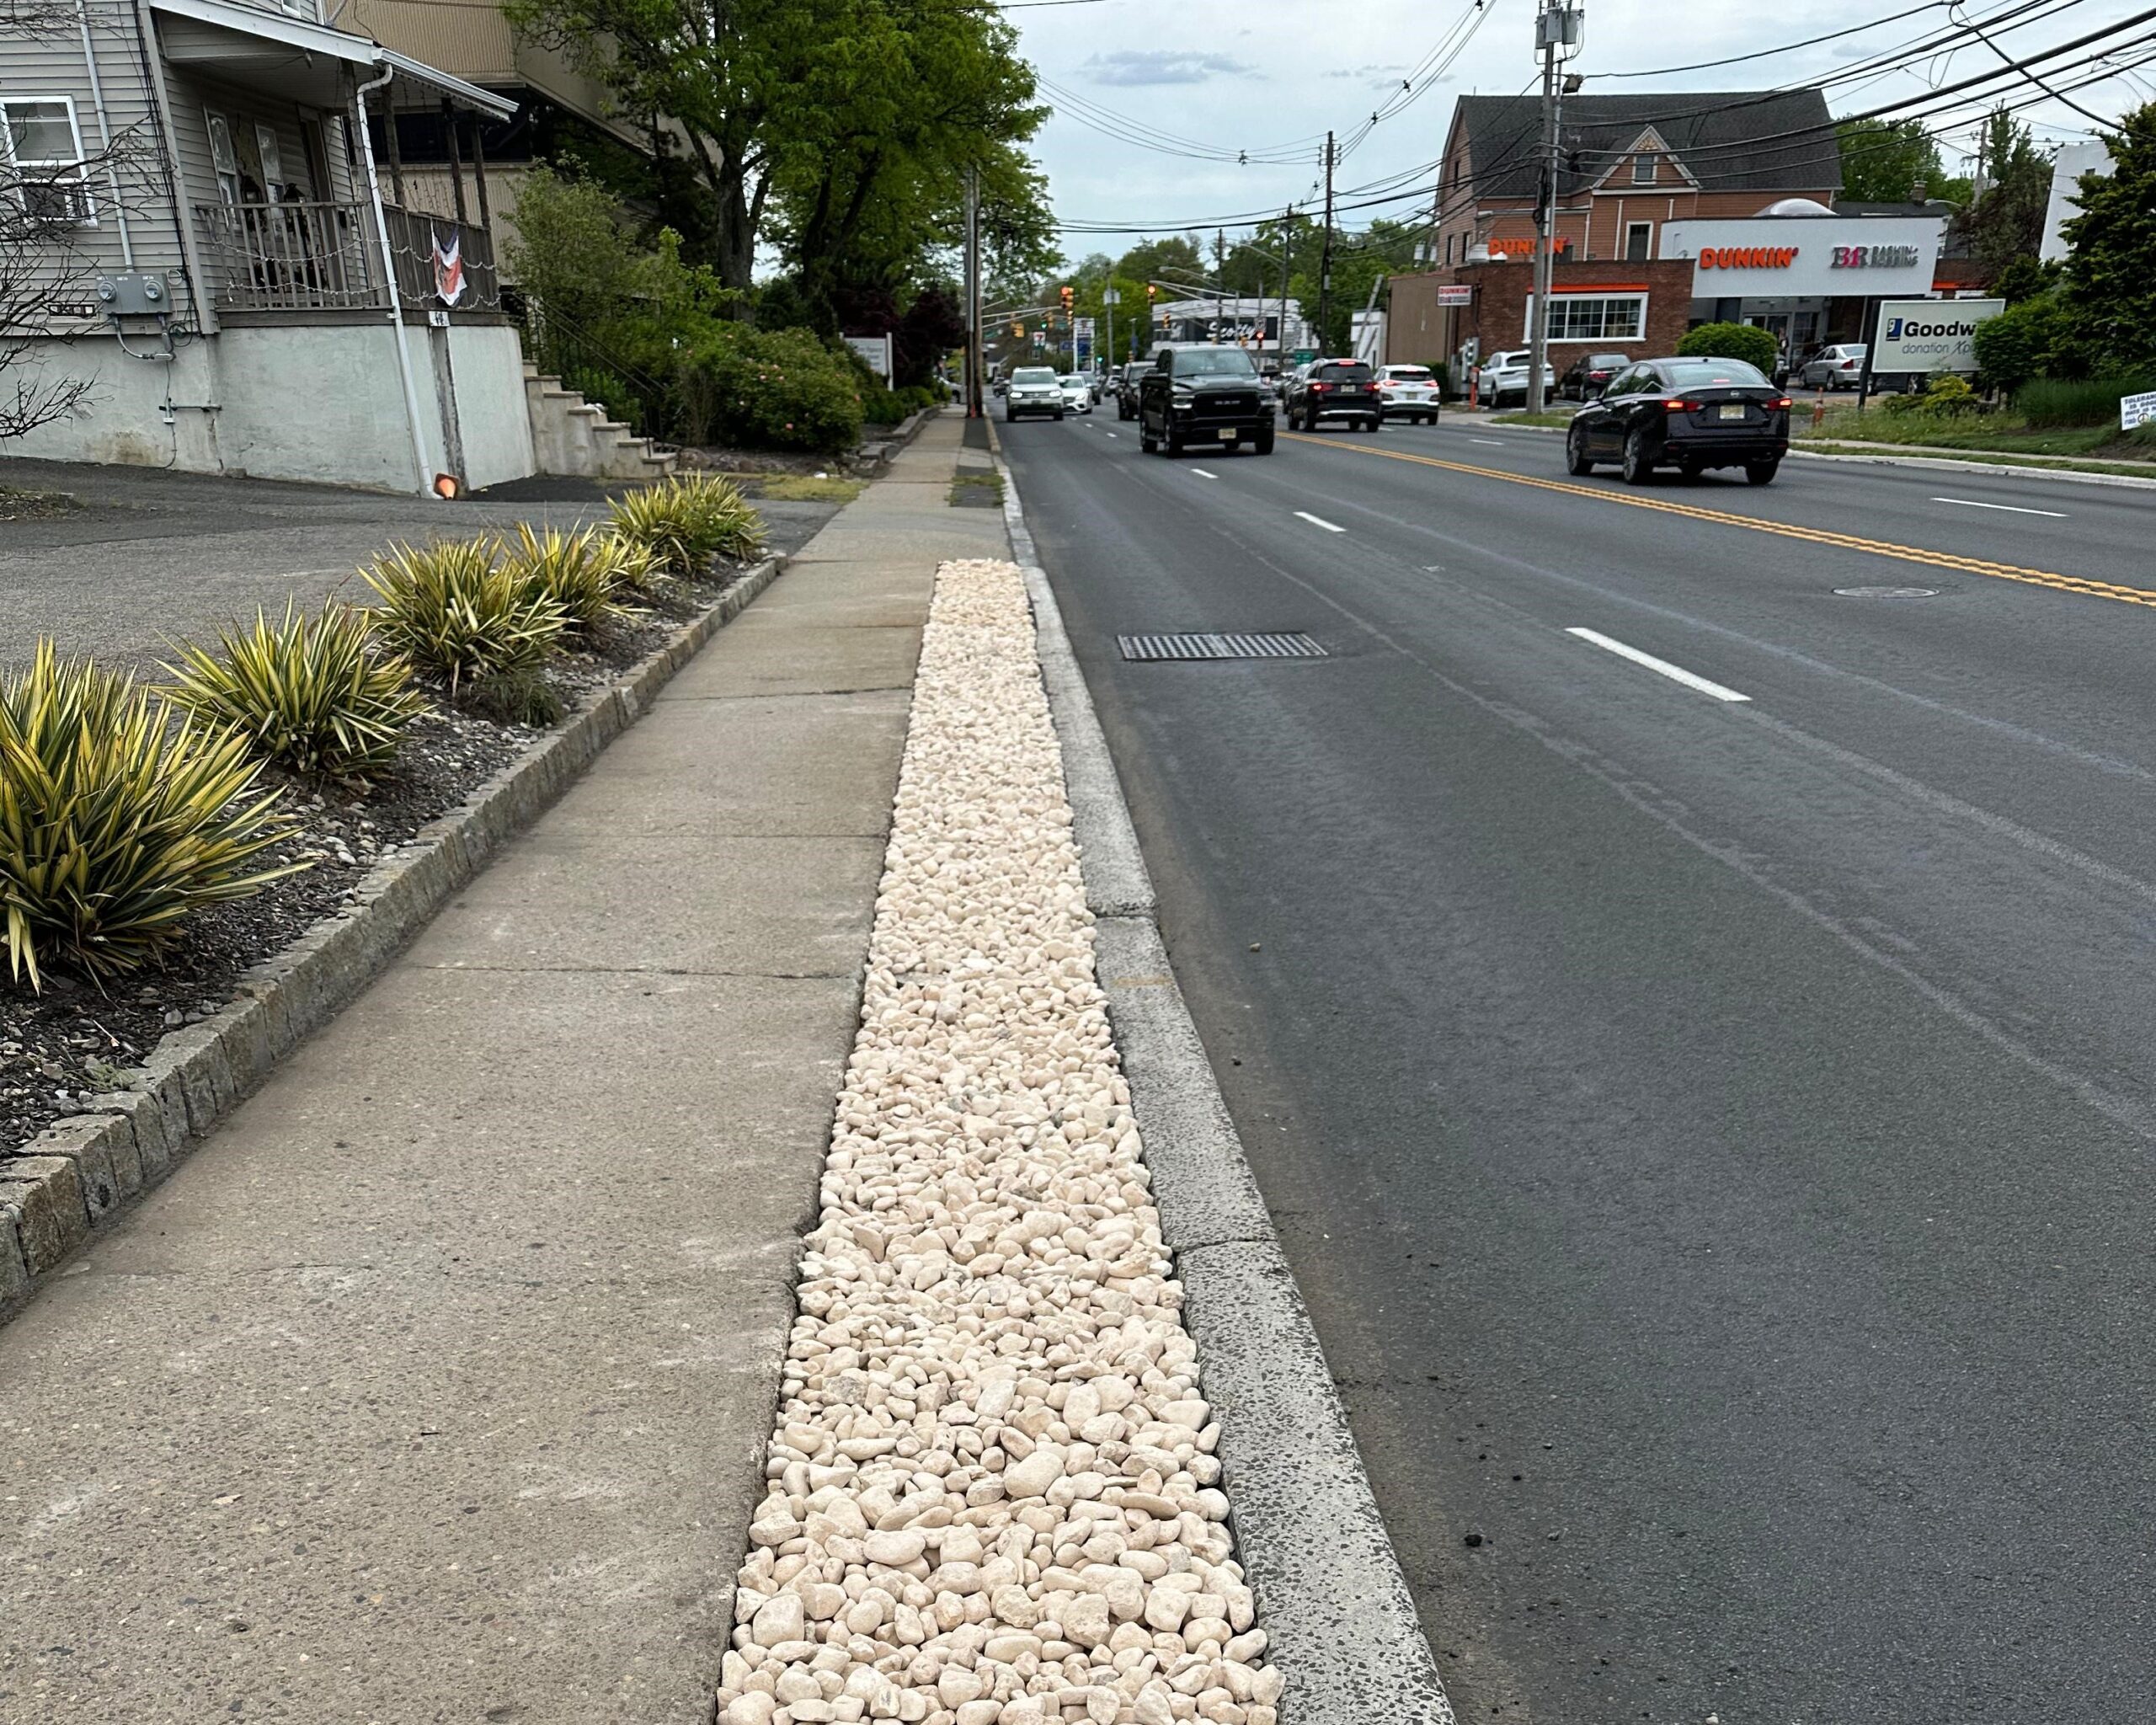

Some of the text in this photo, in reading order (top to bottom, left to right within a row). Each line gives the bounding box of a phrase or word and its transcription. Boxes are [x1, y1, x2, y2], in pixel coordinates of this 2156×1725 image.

[1700, 247, 1800, 270] DUNKIN'
[1904, 321, 1976, 337] Goodw
[1902, 343, 1949, 355] donation
